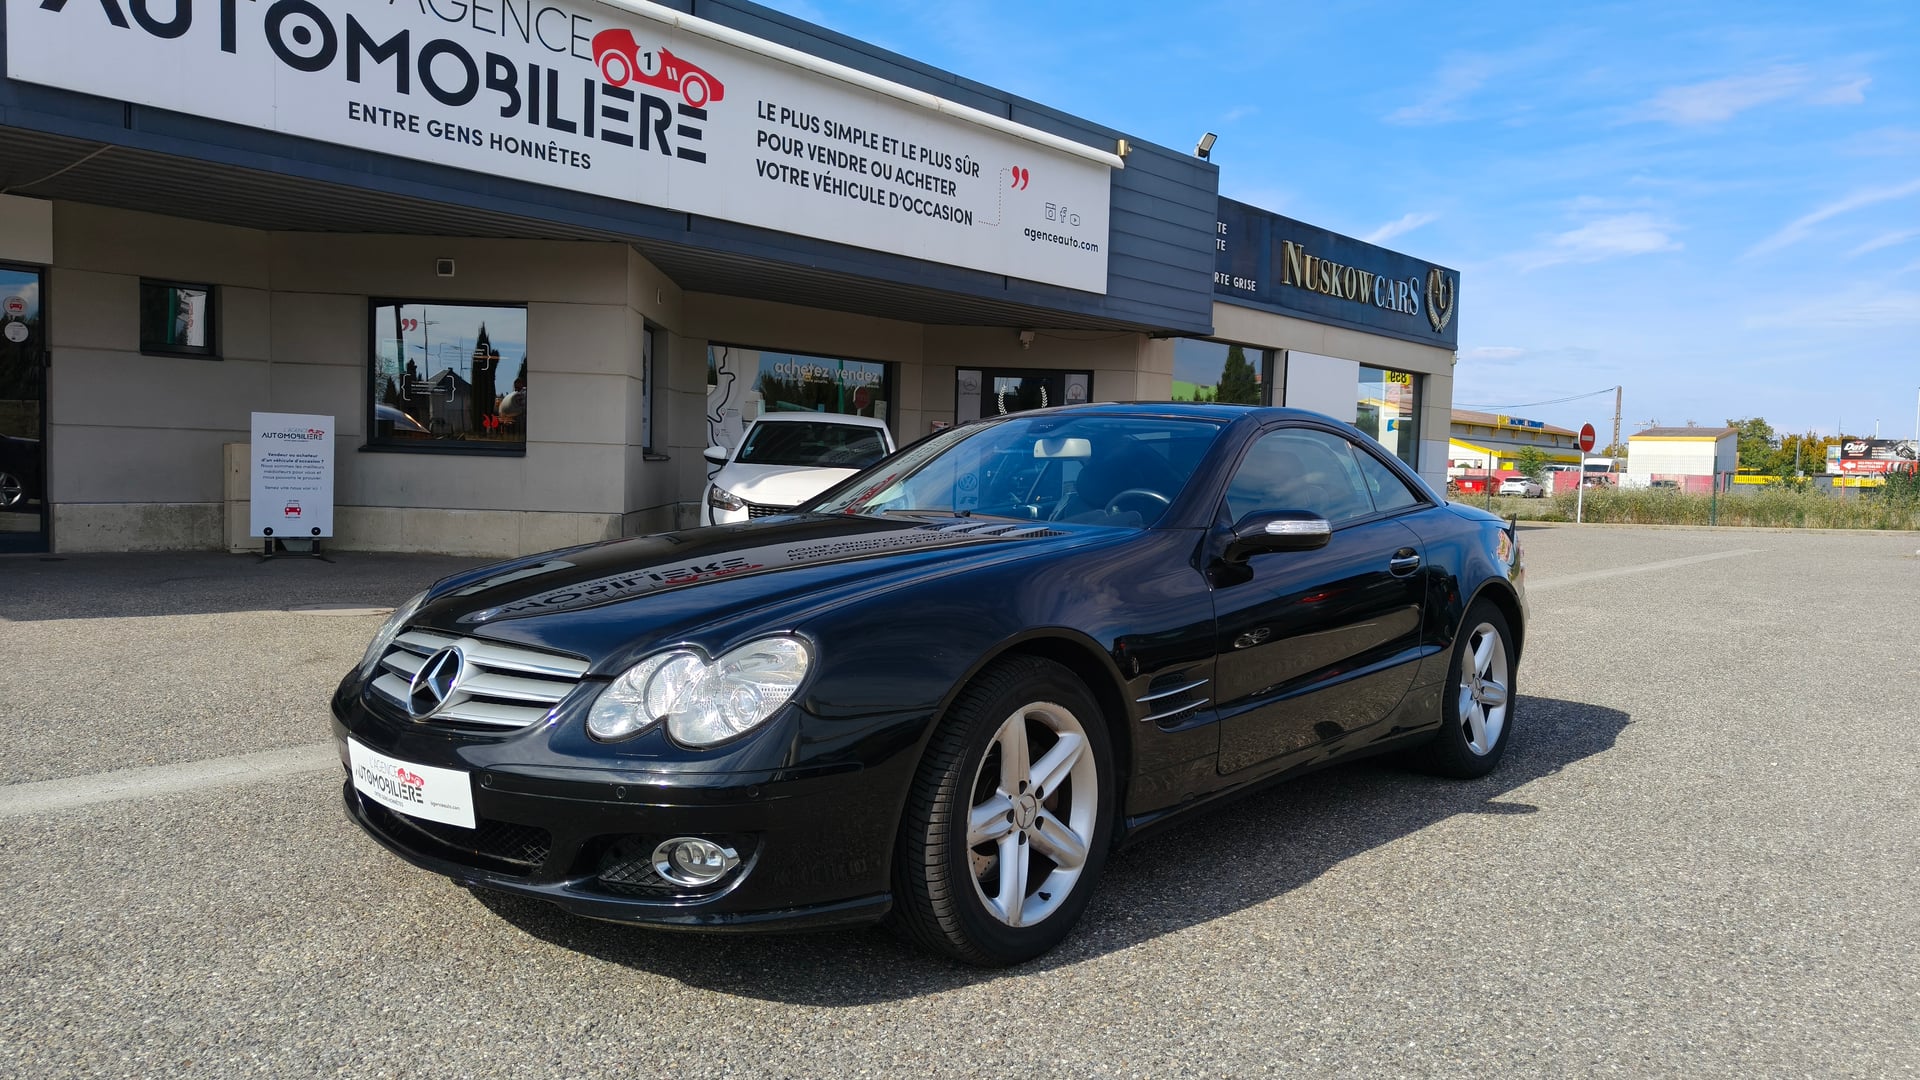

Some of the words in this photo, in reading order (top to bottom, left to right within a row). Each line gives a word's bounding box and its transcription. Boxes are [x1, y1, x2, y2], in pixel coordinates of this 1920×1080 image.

[389, 0, 592, 61] GENCE
[349, 101, 420, 133] ENTRE
[427, 119, 483, 147] GENS
[490, 133, 591, 170] HONNÊTES
[758, 100, 776, 122] LE
[781, 107, 820, 134] PLUS
[824, 120, 879, 150] SIMPLE
[882, 136, 898, 155] ET
[901, 141, 916, 161] LE
[920, 147, 951, 170] PLUS
[955, 155, 980, 178] SÛR
[757, 130, 804, 158] POUR
[807, 143, 867, 174] VENDRE
[871, 161, 892, 181] OU
[895, 168, 957, 197] ACHETER
[756, 158, 809, 188] VOTRE
[813, 170, 885, 206] VÉHICULE
[889, 191, 973, 226] D'OCCASION
[1024, 227, 1099, 253] agenceauto.com
[1216, 221, 1227, 235] TE
[1216, 238, 1226, 251] TE
[1214, 271, 1230, 286] RTE
[1233, 277, 1256, 292] GRISE
[774, 358, 829, 378] achetez
[834, 365, 880, 382] vendez
[1844, 443, 1869, 452] Dafy
